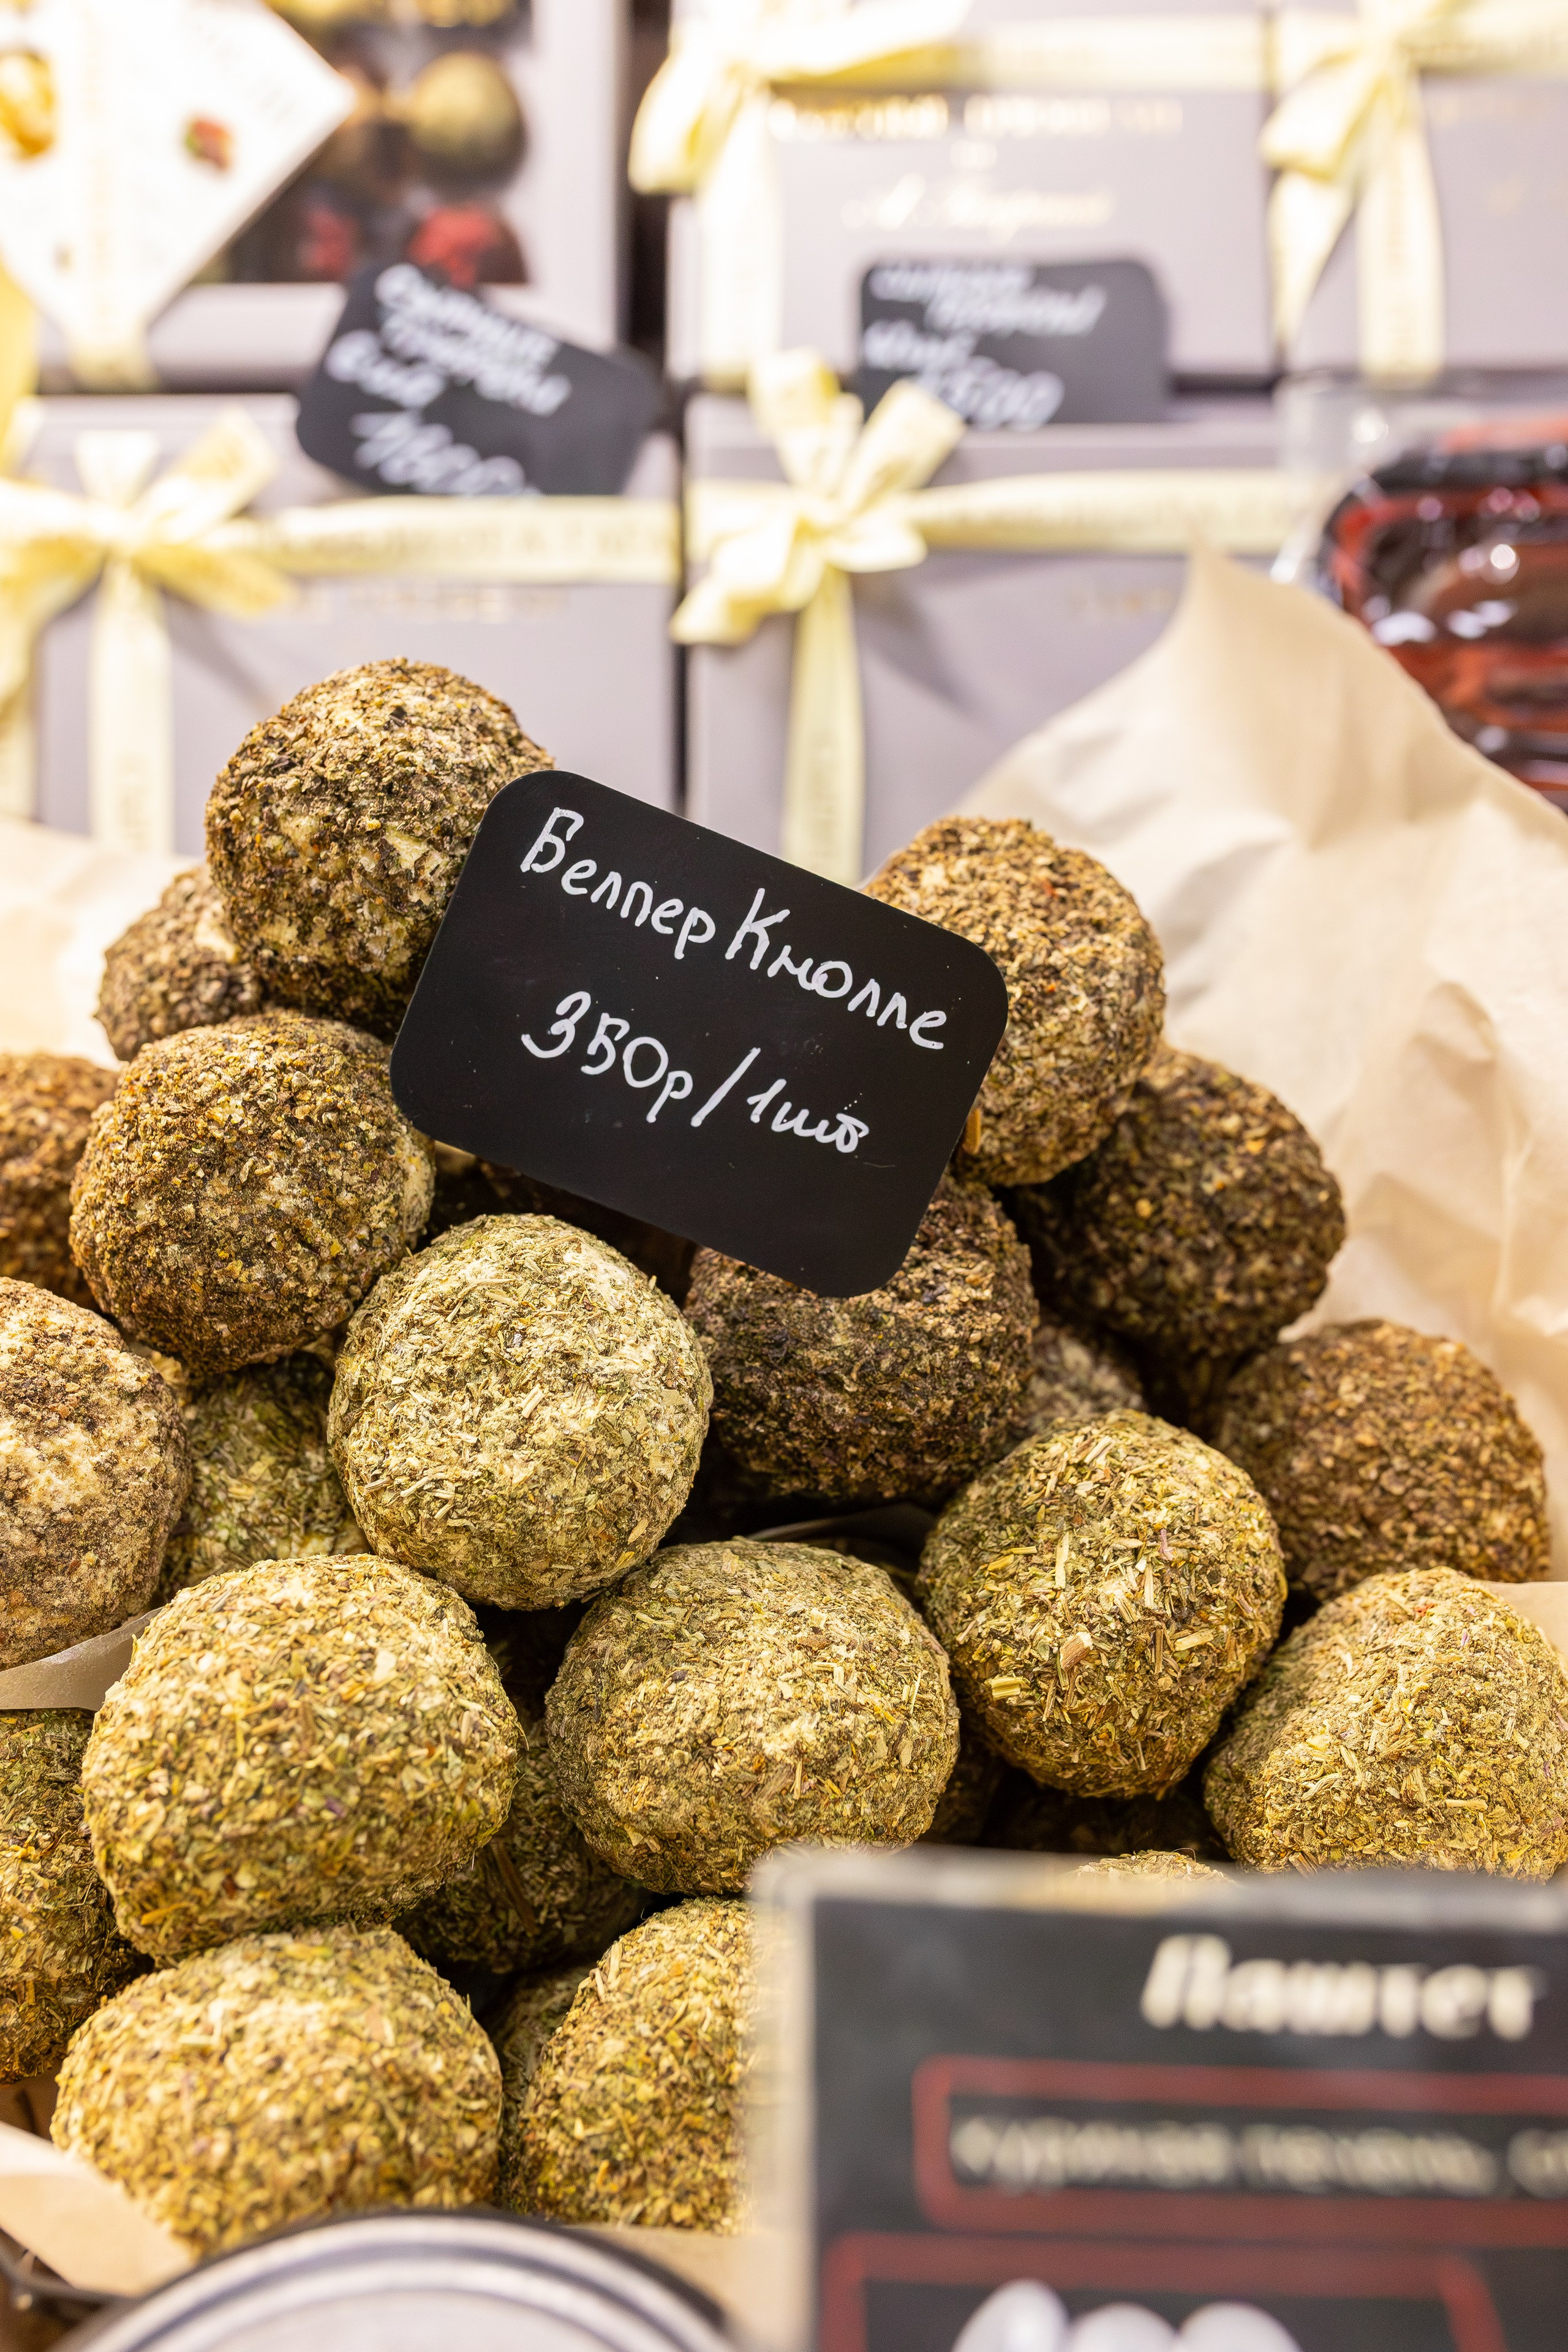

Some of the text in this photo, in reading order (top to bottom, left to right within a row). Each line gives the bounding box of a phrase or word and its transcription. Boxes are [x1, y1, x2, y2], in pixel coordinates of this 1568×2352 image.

[519, 806, 948, 1050] Белпер Кнолле
[1140, 1932, 1544, 2041] Паштет
